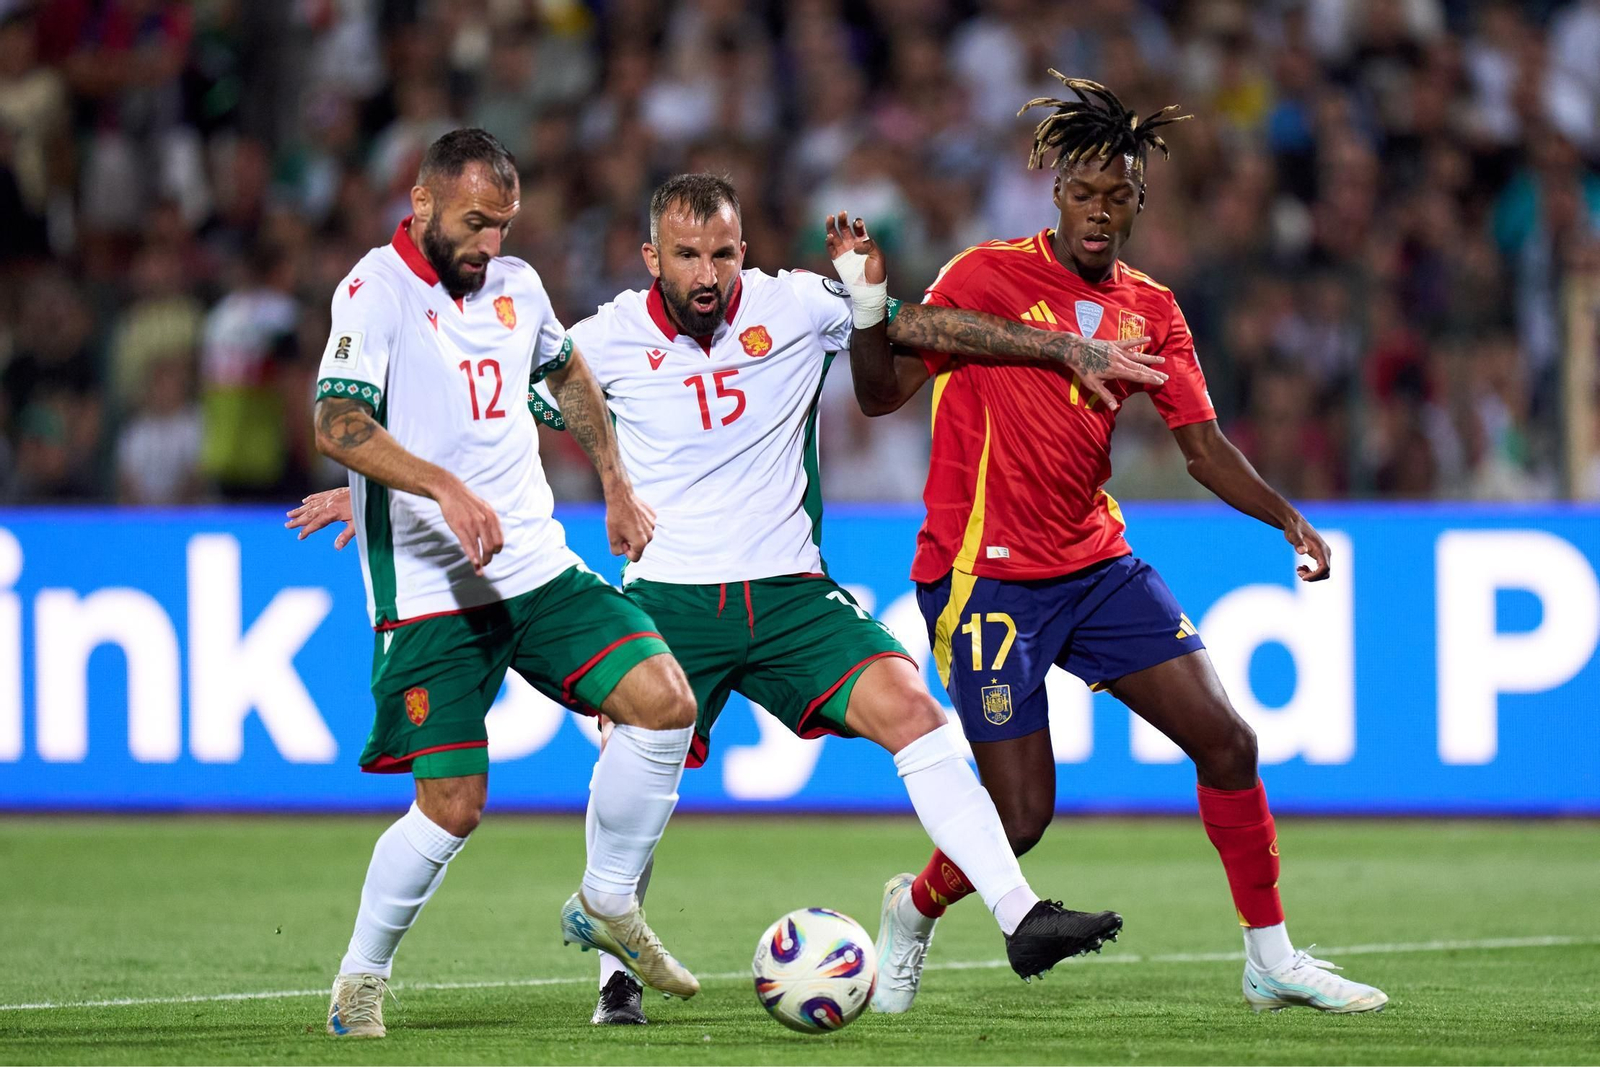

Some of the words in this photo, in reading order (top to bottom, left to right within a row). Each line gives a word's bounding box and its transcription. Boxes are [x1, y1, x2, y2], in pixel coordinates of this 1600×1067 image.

[459, 358, 506, 421] 12
[683, 369, 746, 430] 15
[961, 612, 1017, 672] 17
